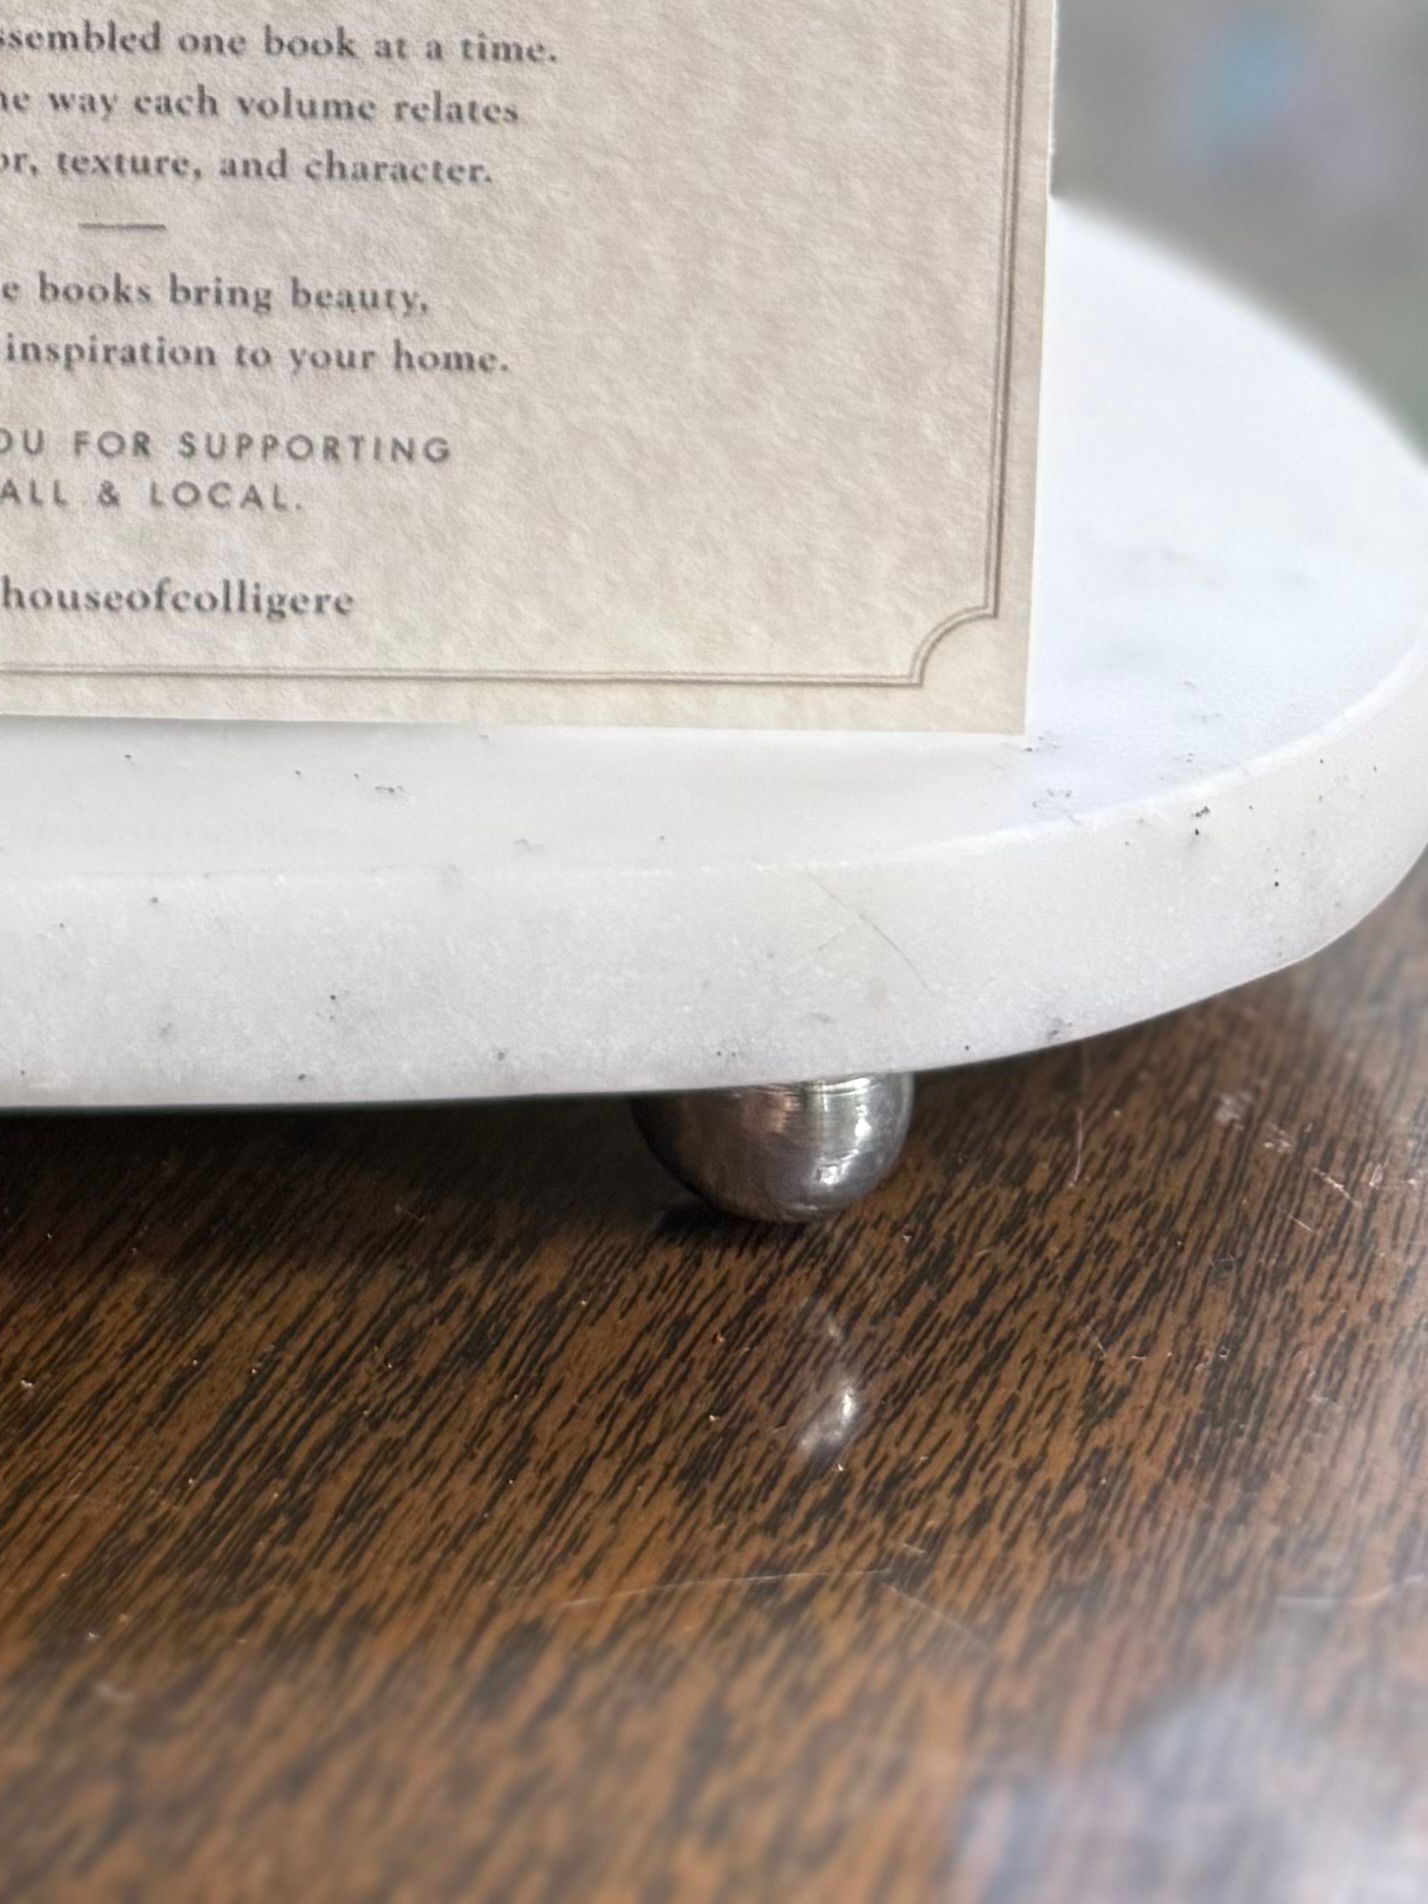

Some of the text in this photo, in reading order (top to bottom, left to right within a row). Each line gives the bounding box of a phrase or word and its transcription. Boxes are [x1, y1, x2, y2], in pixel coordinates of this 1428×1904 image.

[176, 33, 248, 58] one
[263, 23, 359, 61] book
[373, 36, 409, 62] at
[424, 39, 445, 63] a
[460, 30, 558, 65] time.
[47, 92, 115, 123] way
[132, 82, 220, 119] each
[235, 86, 377, 123] volume
[394, 89, 521, 126] relates
[56, 151, 203, 182] texture,
[218, 146, 290, 181] and
[303, 148, 493, 186] character.
[37, 269, 153, 308] books
[168, 271, 273, 318] bring
[289, 275, 430, 319] beauty,
[5, 332, 218, 374] inspiration
[234, 343, 274, 371] to
[288, 347, 377, 376] your
[392, 338, 510, 376] home.
[72, 430, 153, 461] FOR
[178, 430, 452, 467] SUPPORTING
[96, 480, 121, 510] &
[149, 480, 304, 514] LOCAL.
